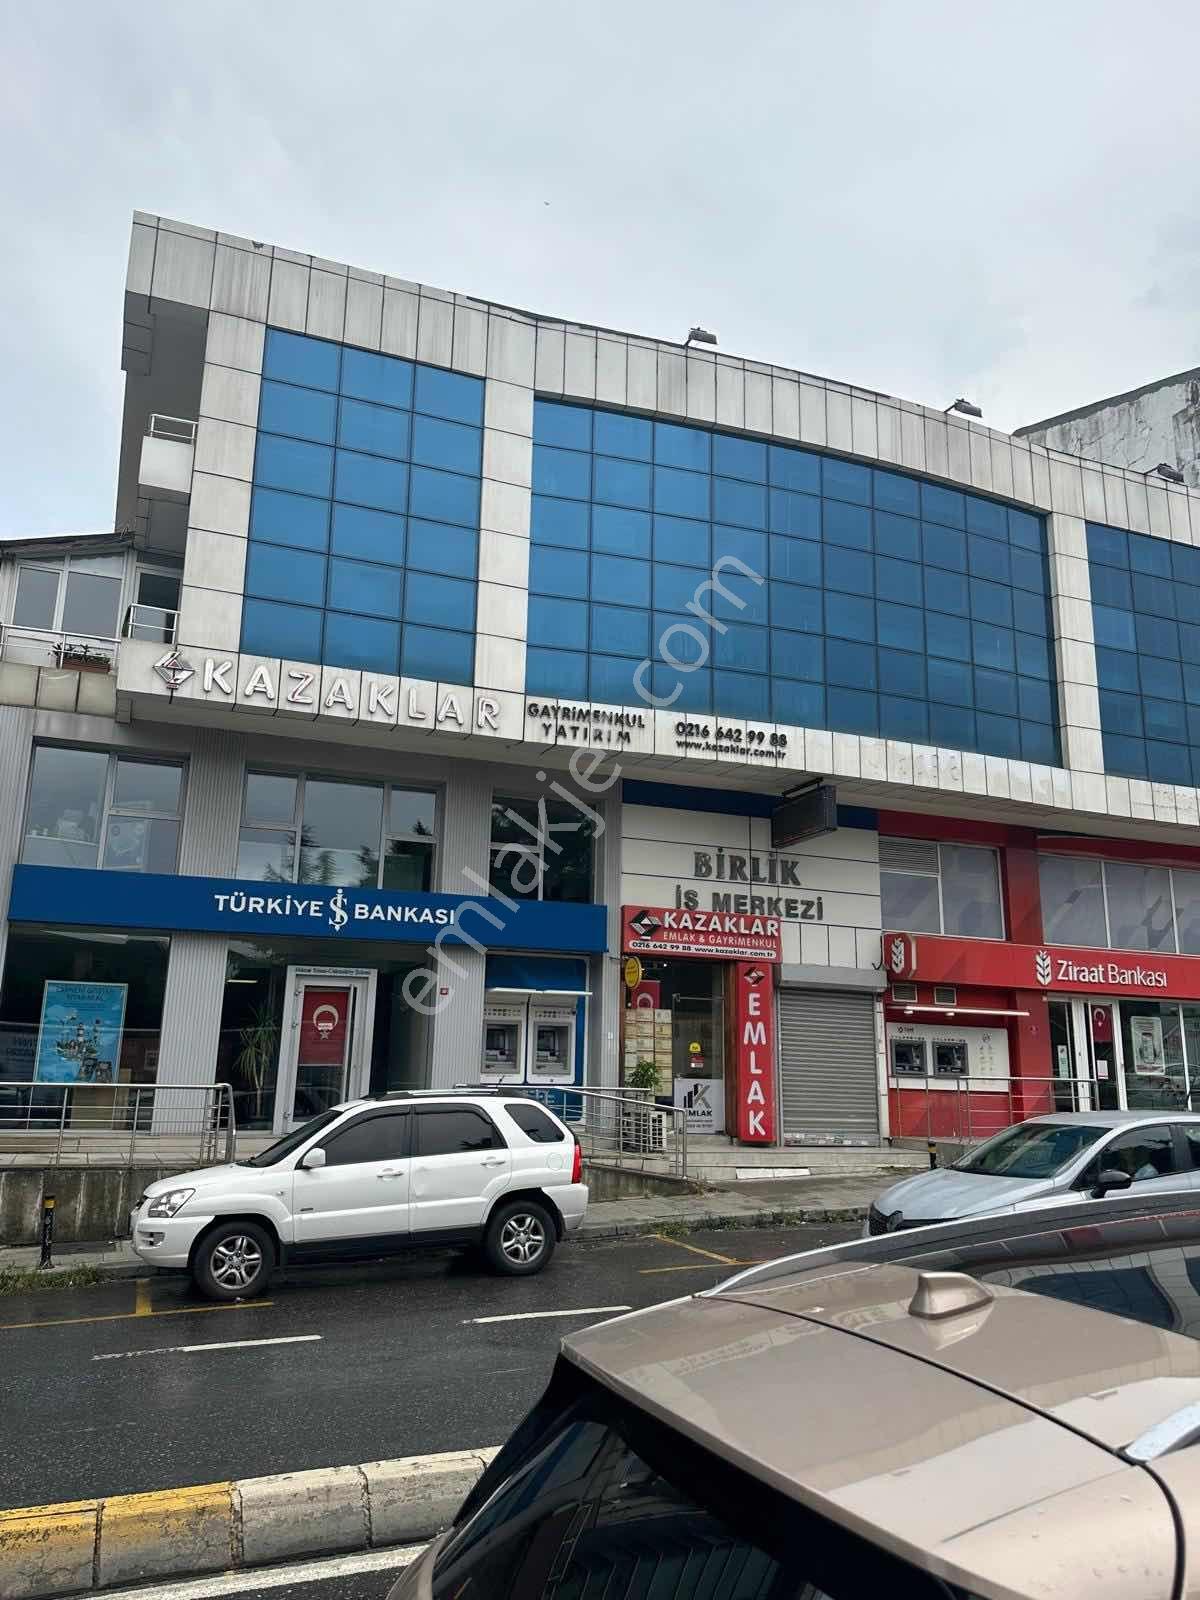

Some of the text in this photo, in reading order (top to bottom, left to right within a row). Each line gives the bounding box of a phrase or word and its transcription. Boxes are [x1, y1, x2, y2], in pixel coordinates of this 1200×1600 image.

[203, 657, 500, 730] KAZAKLAR
[527, 702, 645, 729] GAYRİMENKUL
[541, 722, 631, 744] YATIRIM
[676, 721, 787, 748] 0216 642 99 88
[693, 846, 802, 886] BİRLİK
[214, 891, 323, 917] TÜRKİYE
[354, 903, 455, 925] BANKASI
[711, 891, 824, 921] MERKEZİ
[663, 911, 779, 937] KAZAKLAR
[663, 931, 696, 942] EMLAK
[1057, 959, 1168, 988] Ziraat Bankası
[743, 992, 766, 1136] EMLAK
